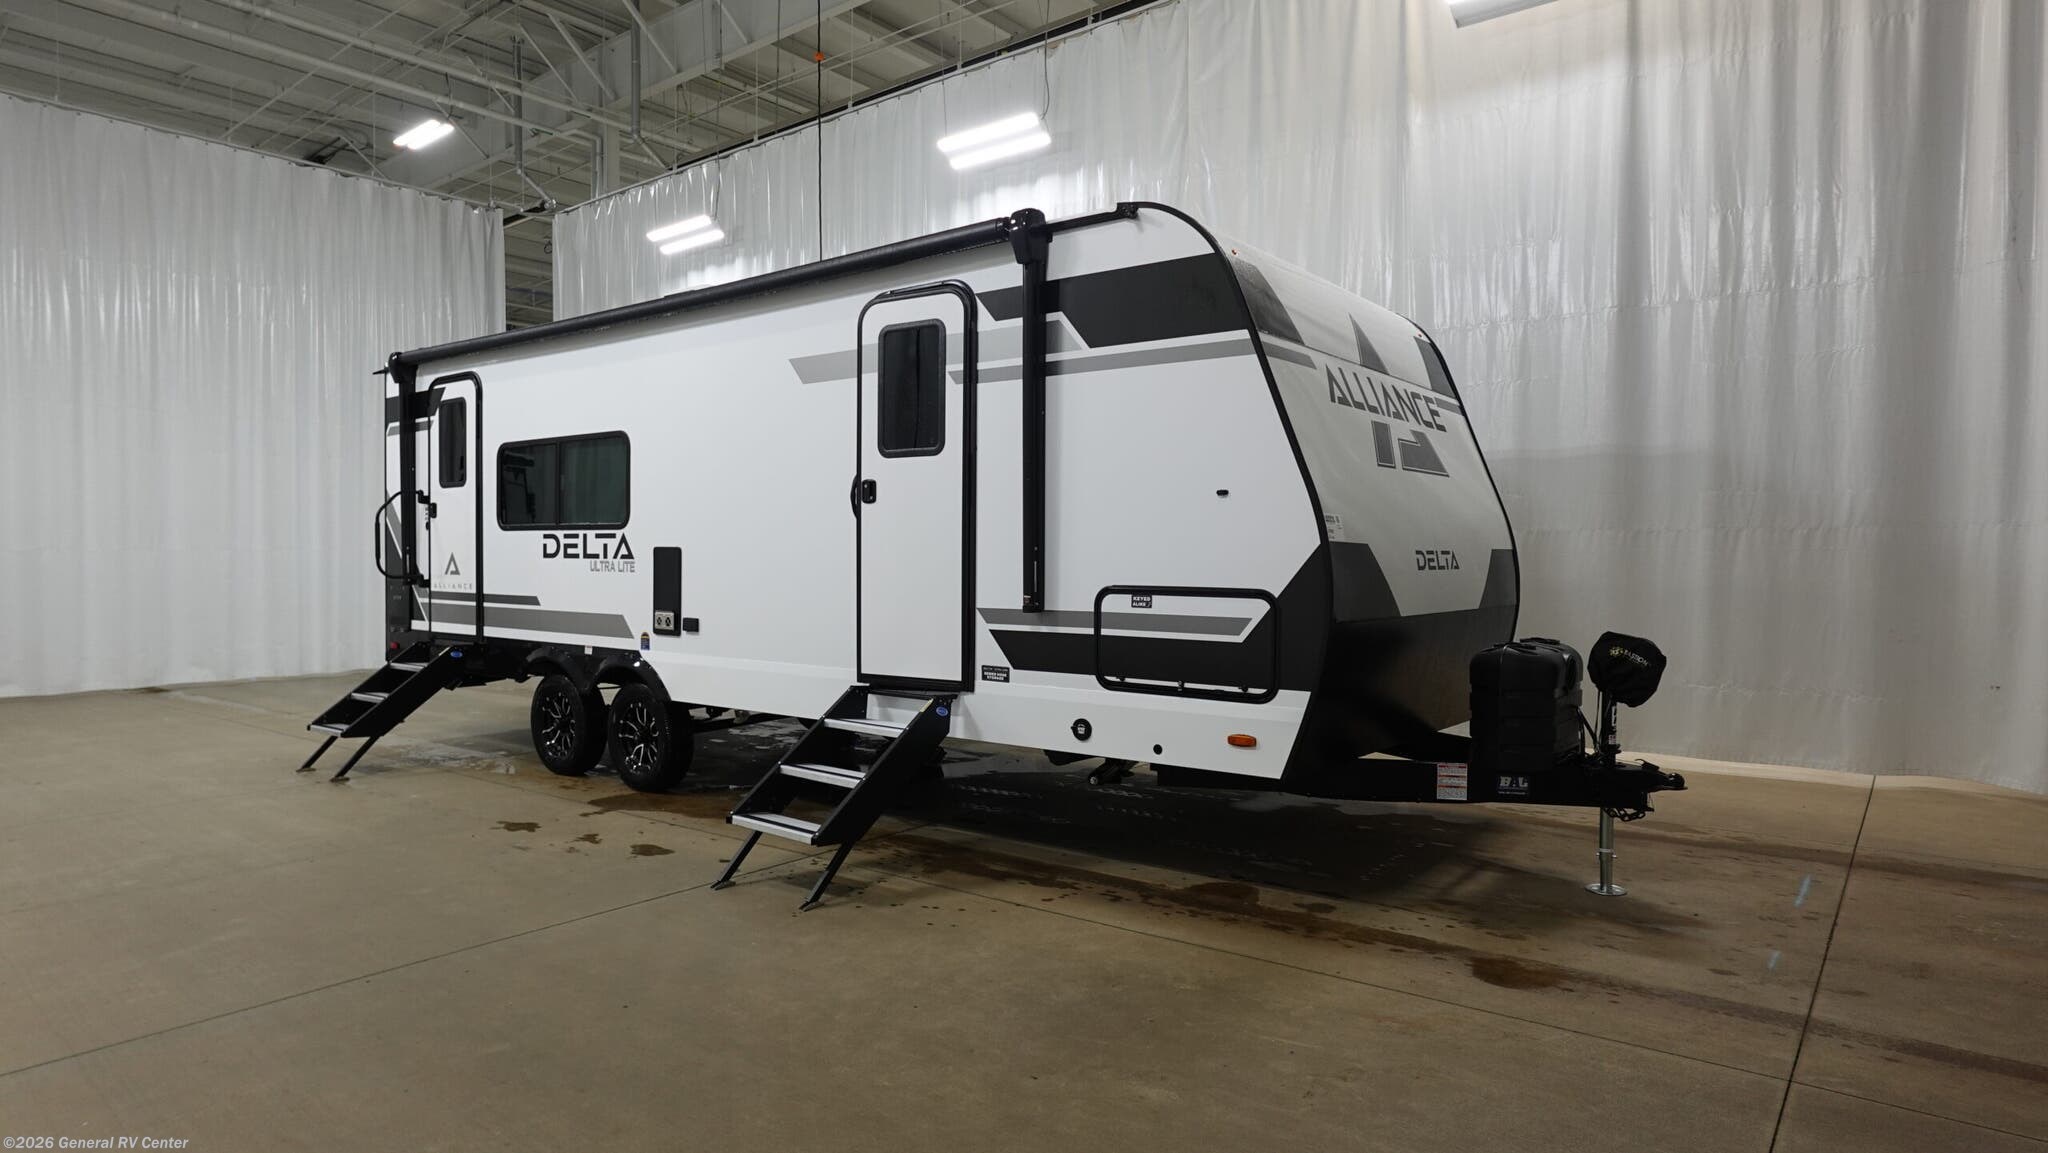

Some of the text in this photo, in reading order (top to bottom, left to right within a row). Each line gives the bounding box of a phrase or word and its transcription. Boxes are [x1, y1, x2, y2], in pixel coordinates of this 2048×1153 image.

[1325, 364, 1447, 432] ALLIANCE
[543, 533, 635, 559] DELTA
[590, 560, 636, 573] ULTRA LITE
[1415, 550, 1460, 571] DELTA
